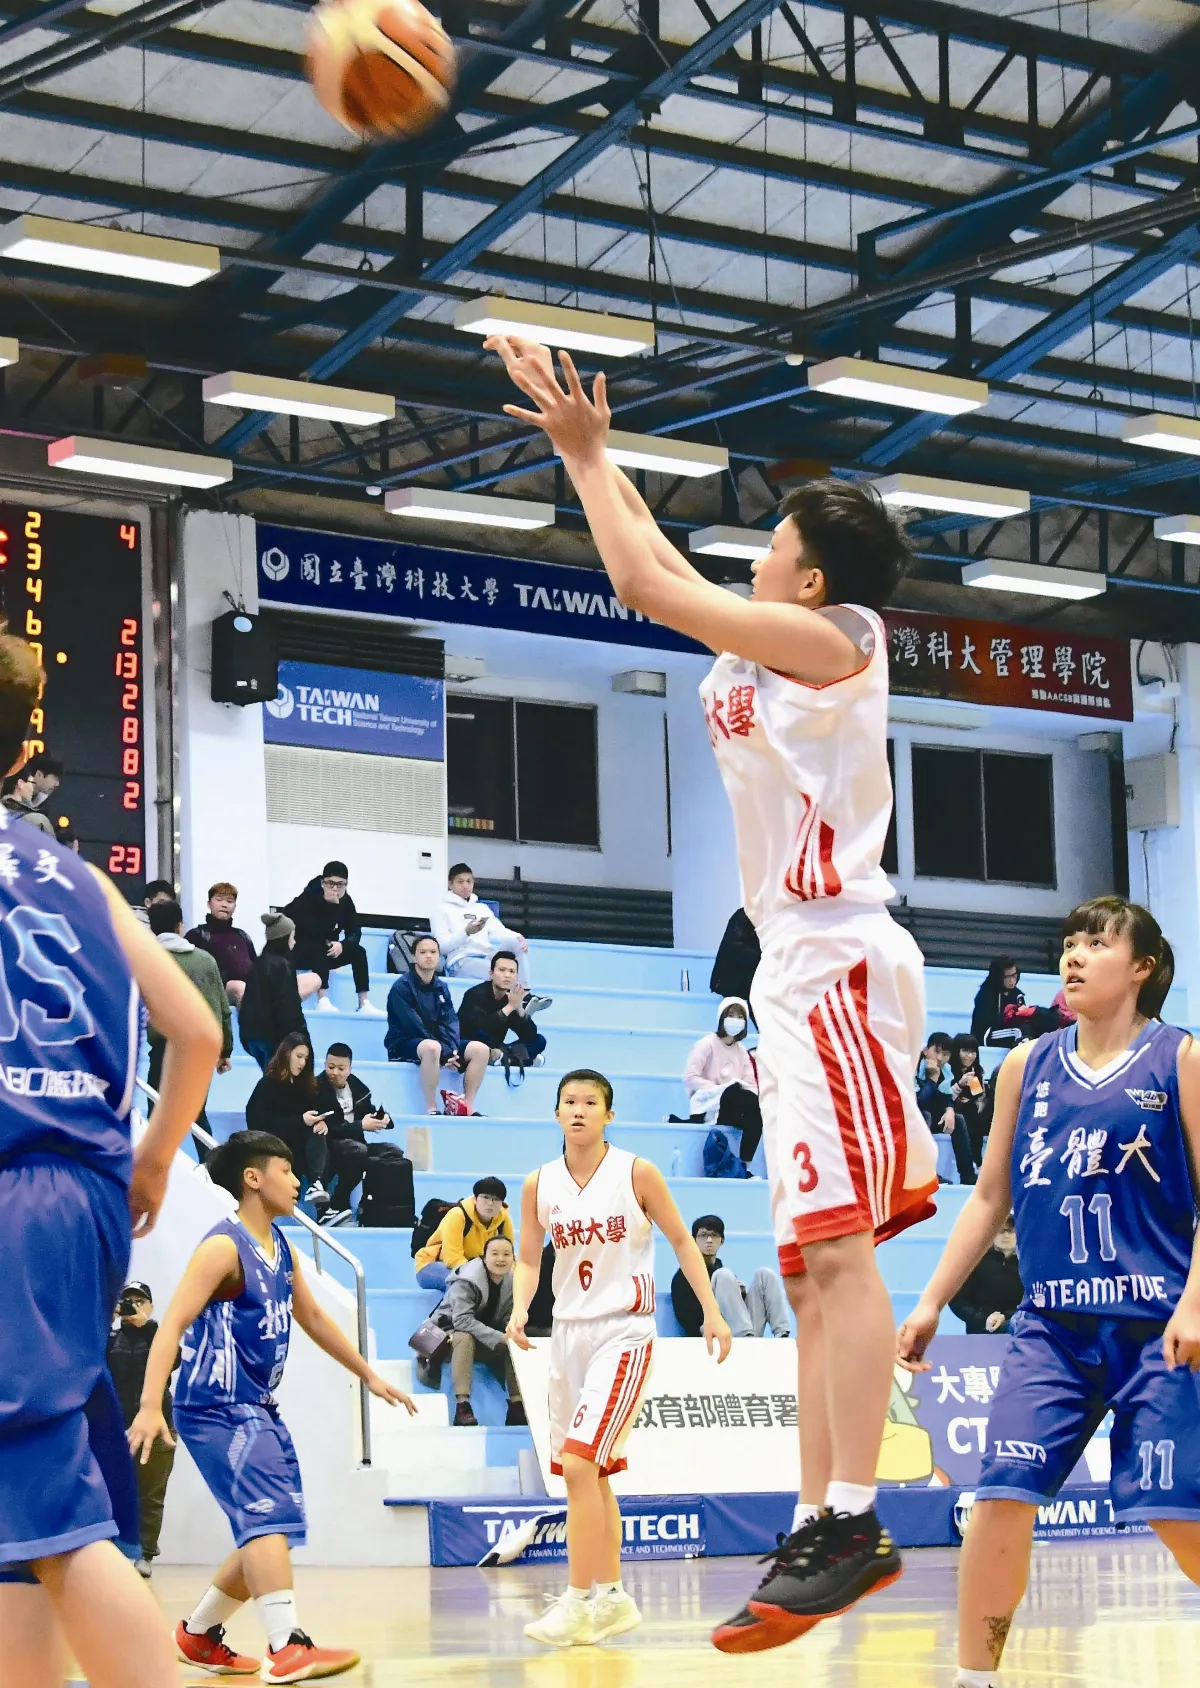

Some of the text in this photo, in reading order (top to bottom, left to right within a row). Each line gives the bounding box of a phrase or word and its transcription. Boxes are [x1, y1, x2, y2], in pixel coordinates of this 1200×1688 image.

[24, 511, 42, 539] 2
[119, 524, 136, 549] 4
[26, 542, 42, 571] 3
[26, 577, 42, 603] 4
[300, 552, 500, 606] 國立臺灣科技大學
[121, 618, 137, 646] 2
[116, 652, 138, 679] 13
[892, 626, 1110, 689] 灣科大管理學院
[122, 683, 139, 710] 2
[296, 685, 380, 711] TAIWAN
[30, 708, 44, 734] 9
[296, 704, 351, 726] TECH
[122, 717, 139, 744] 8
[122, 748, 140, 776] 8
[123, 782, 140, 809] 2
[108, 845, 141, 875] 23
[791, 1141, 819, 1193] 3
[1019, 1123, 1161, 1189] 臺體大
[1059, 1193, 1117, 1265] 11
[578, 1260, 594, 1292] 6
[572, 1404, 588, 1429] 6
[1138, 1439, 1175, 1491] 11
[1036, 1500, 1096, 1525] WAN
[620, 1513, 700, 1541] TECH
[1091, 1525, 1116, 1535] SCIENCE
